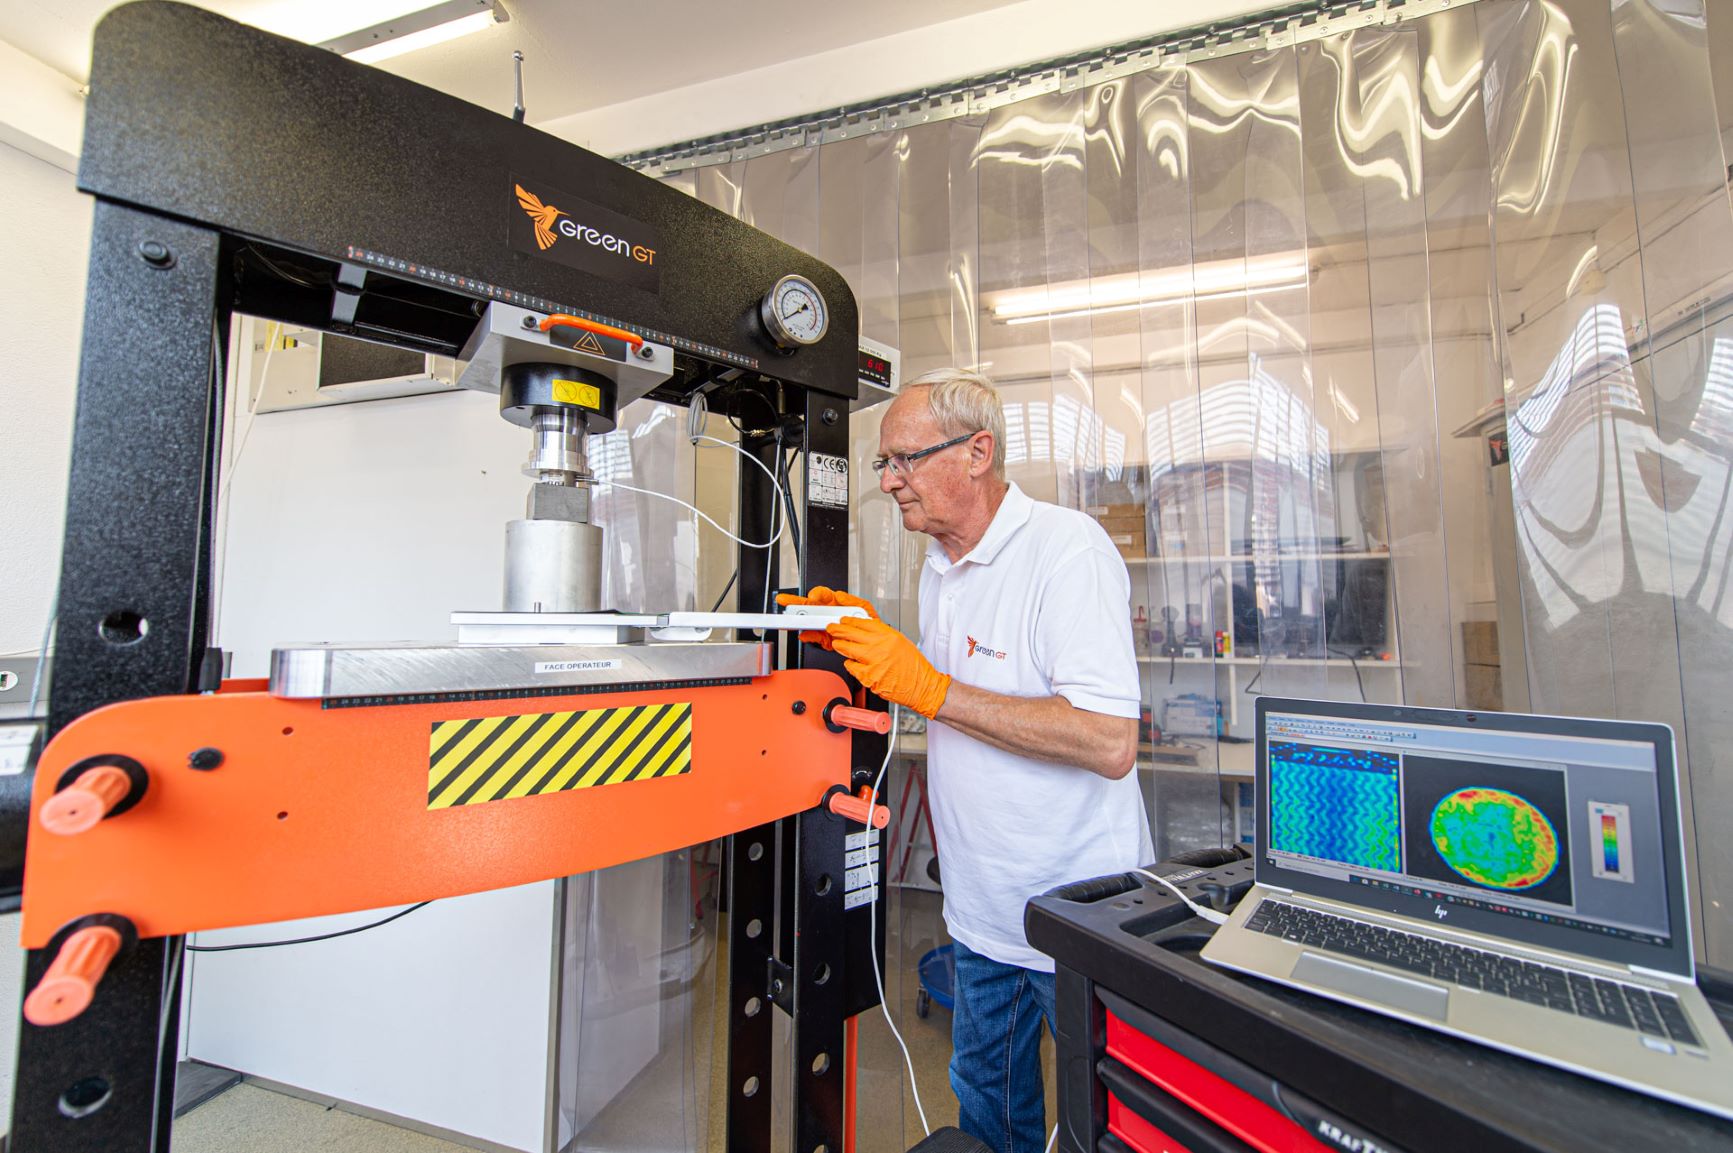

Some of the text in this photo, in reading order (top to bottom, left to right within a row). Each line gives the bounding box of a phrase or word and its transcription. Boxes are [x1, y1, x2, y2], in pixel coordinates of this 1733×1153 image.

[559, 219, 656, 265] Green GT
[567, 661, 612, 670] OPERATEUR
